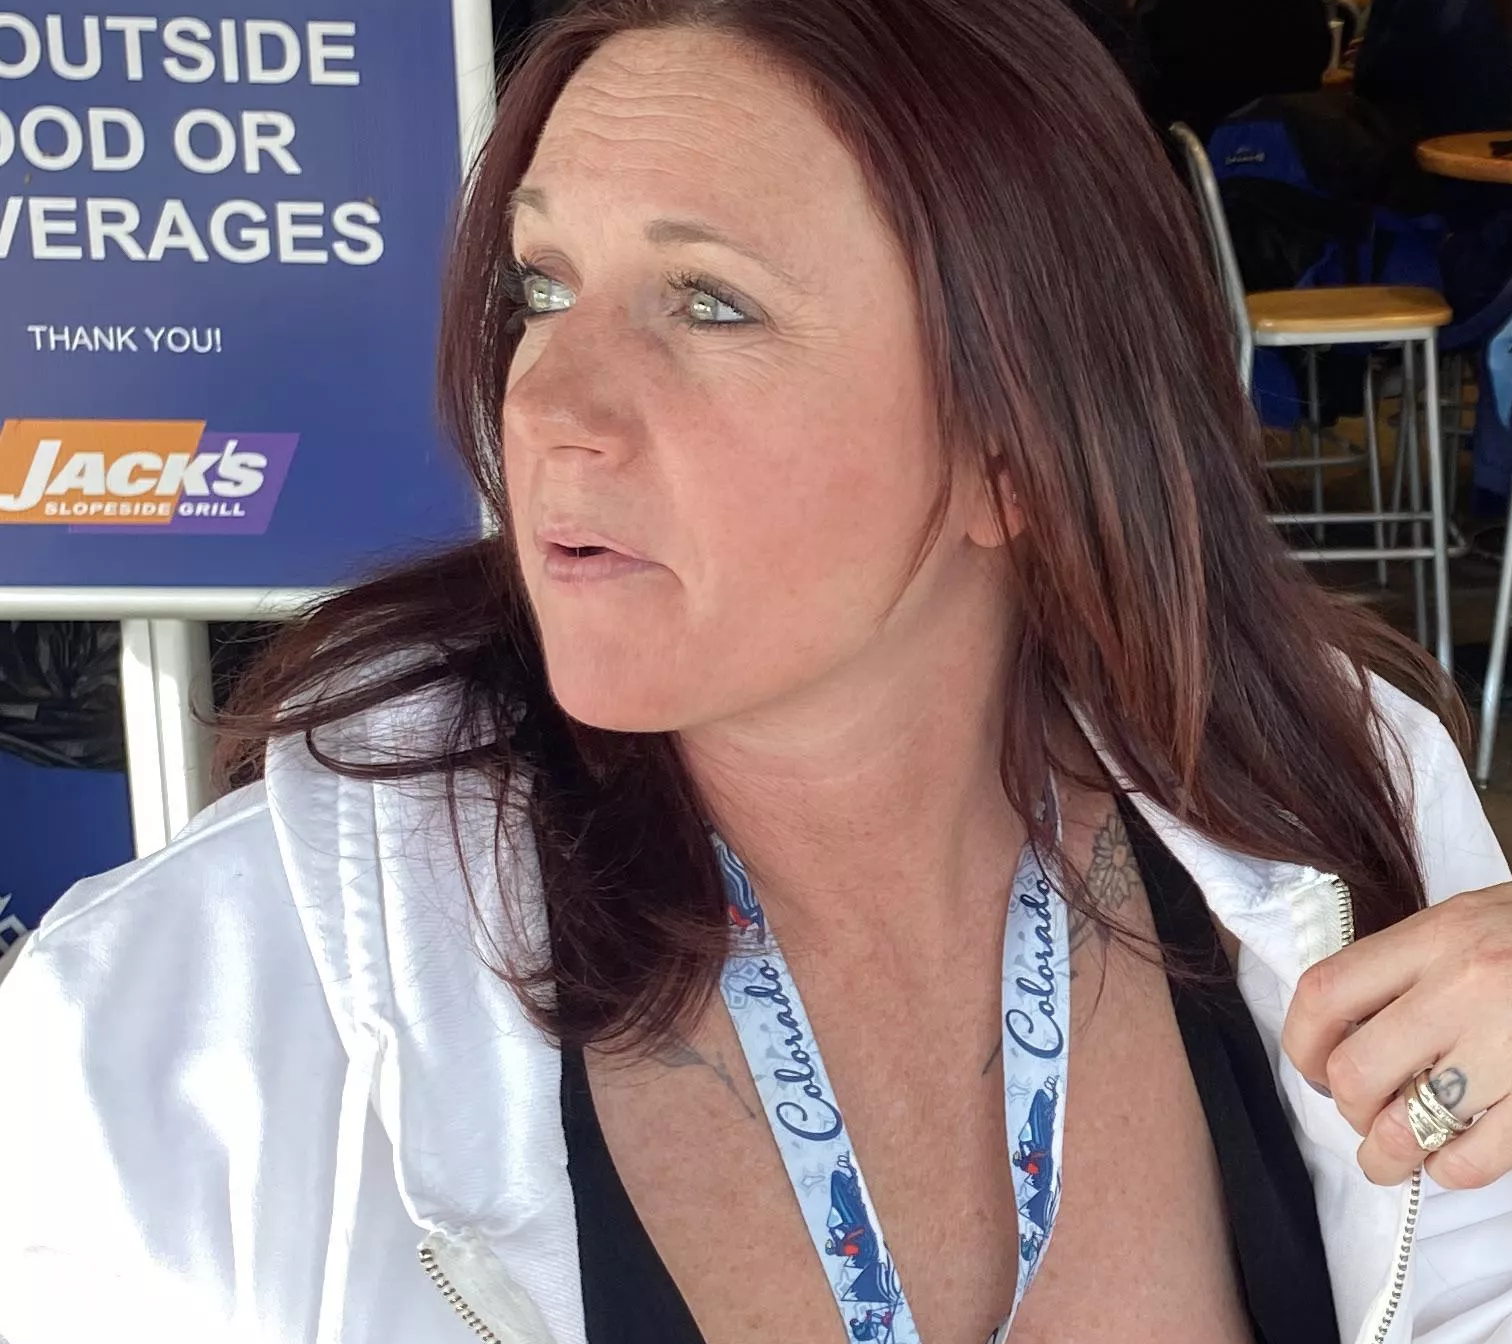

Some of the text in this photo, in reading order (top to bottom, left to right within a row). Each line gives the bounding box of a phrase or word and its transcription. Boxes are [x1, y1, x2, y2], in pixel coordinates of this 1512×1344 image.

[0, 12, 361, 86] OUTSIDE
[0, 105, 302, 175] OD OR
[27, 325, 222, 354] THANK YOU!
[0, 439, 268, 512] JACK'S
[44, 502, 246, 517] SLOPESIDE GRILL
[1006, 872, 1064, 1059] Colorado
[745, 958, 843, 1142] Colorado
